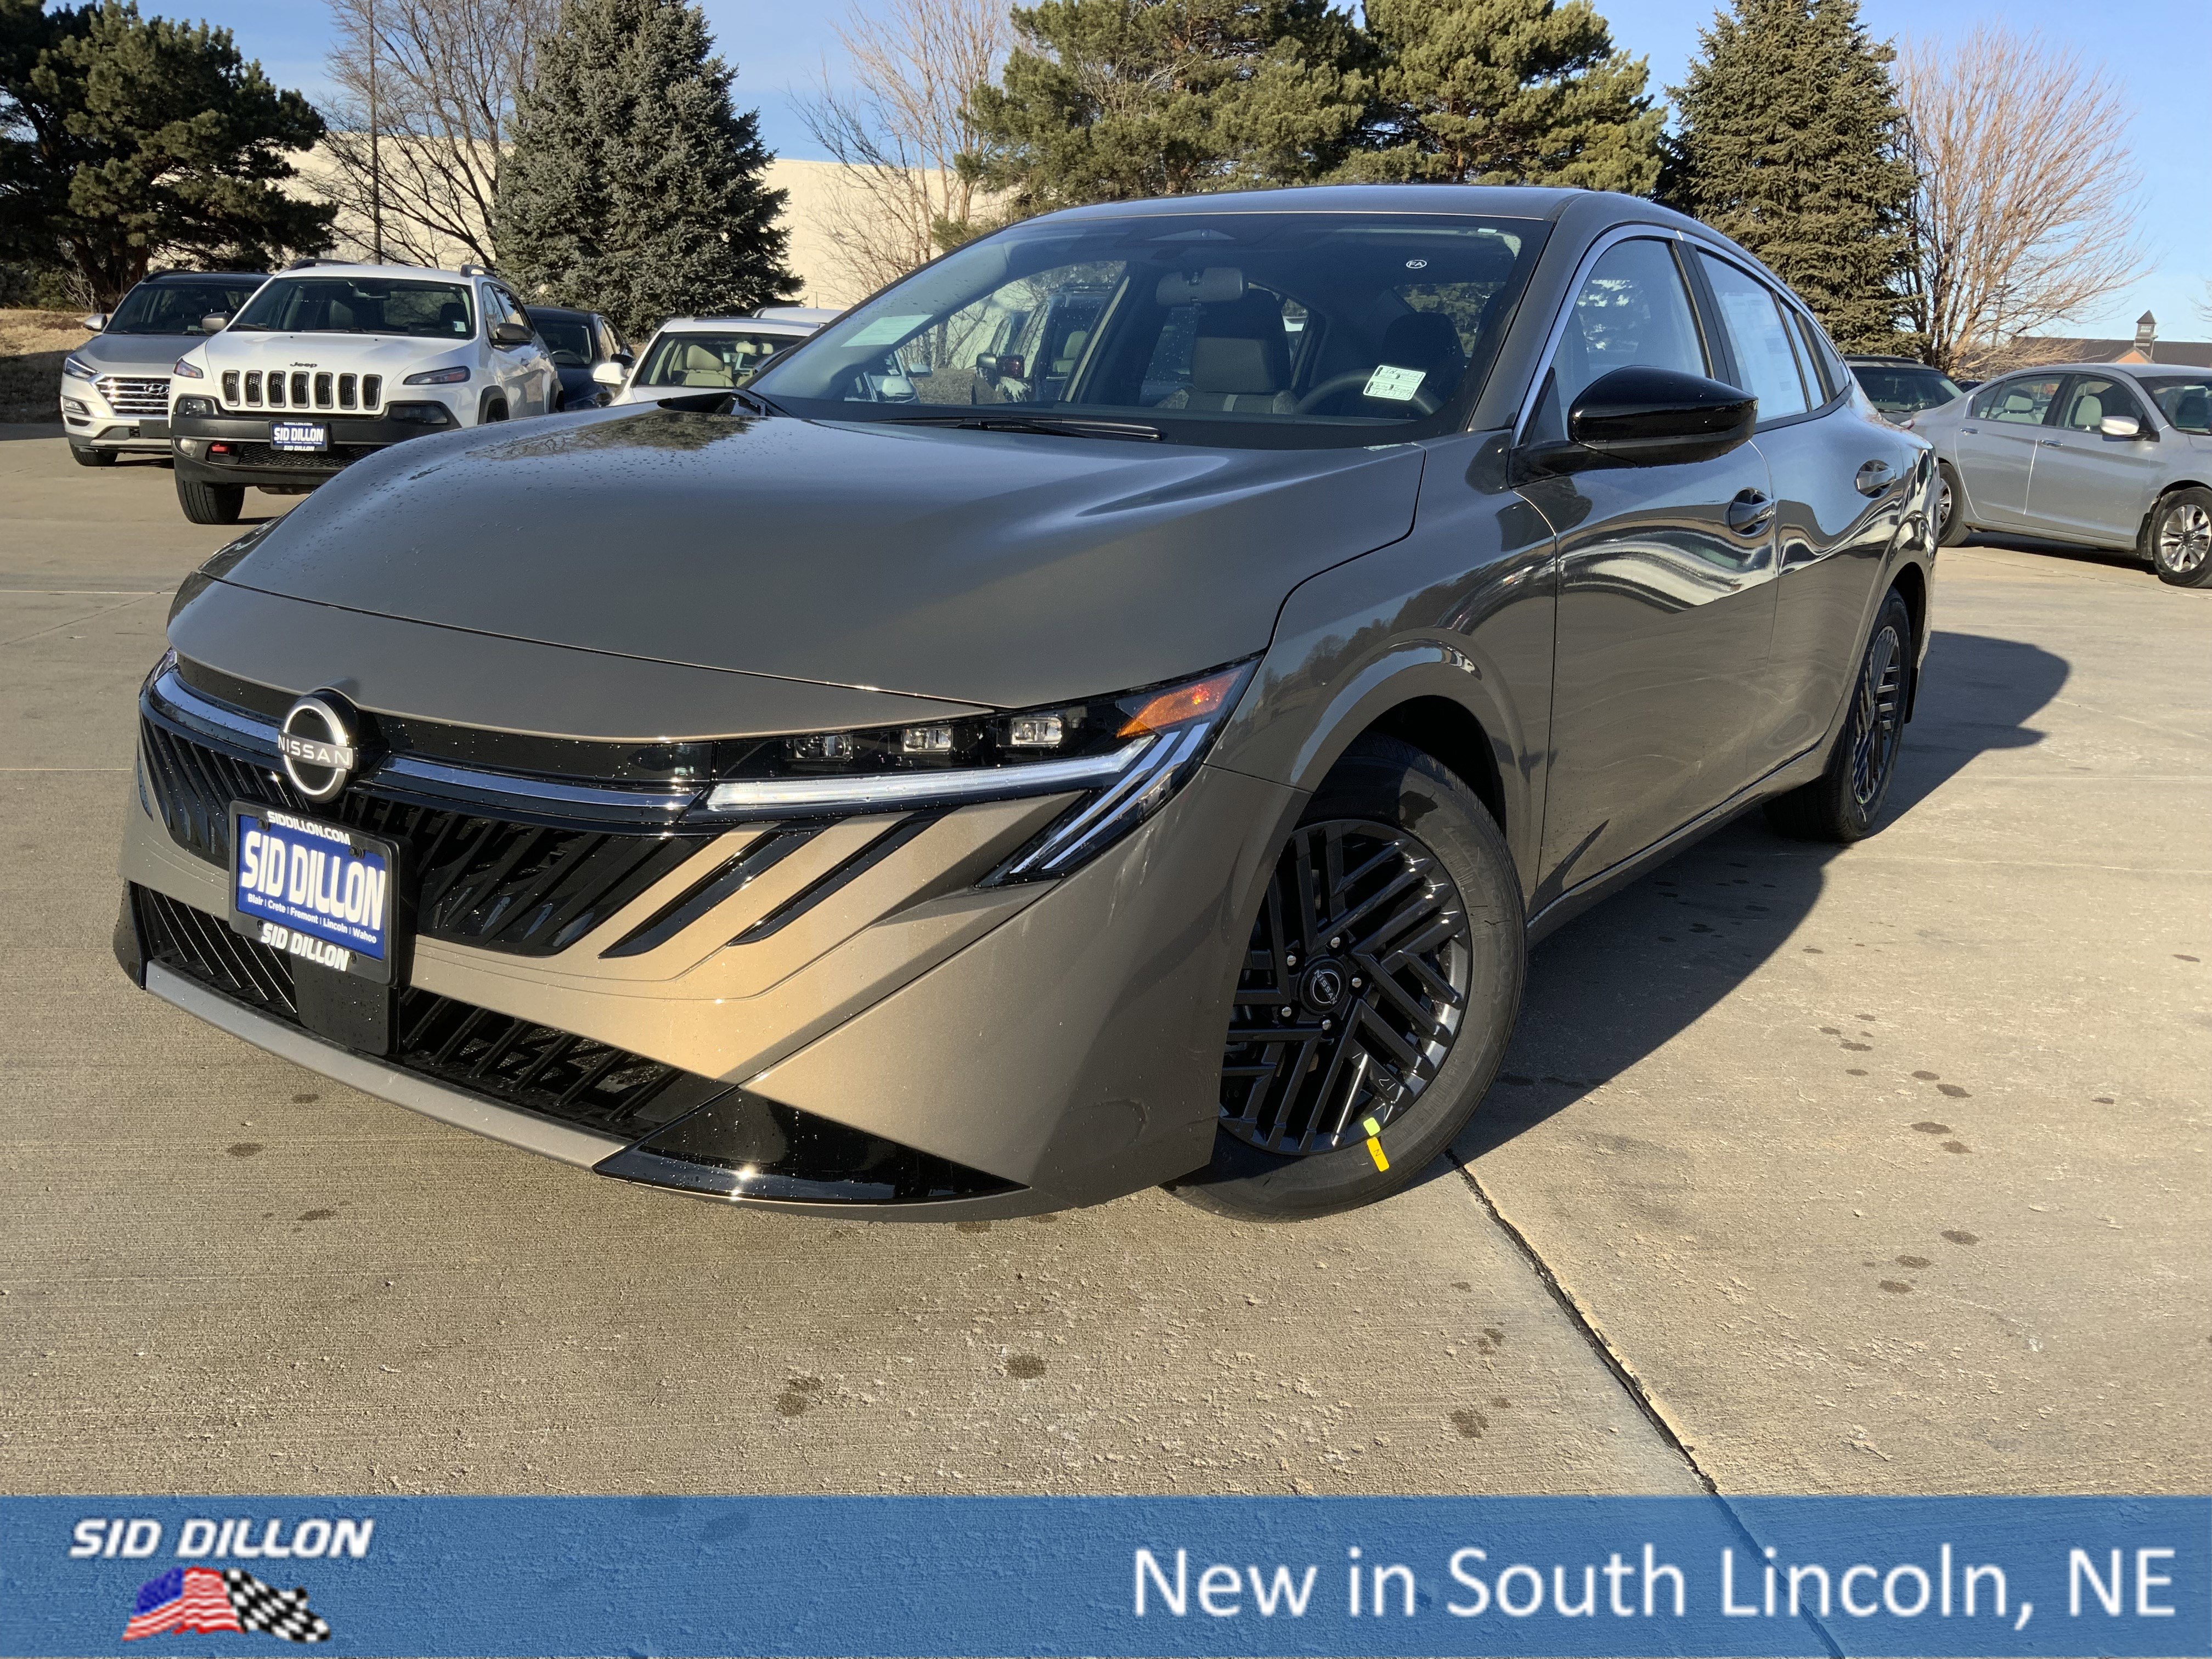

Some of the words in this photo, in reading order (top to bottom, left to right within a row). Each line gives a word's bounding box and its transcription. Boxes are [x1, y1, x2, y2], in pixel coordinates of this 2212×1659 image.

[274, 427, 290, 441] SID
[291, 428, 324, 442] DILLON
[278, 734, 349, 765] NISSAN
[267, 811, 351, 845] SIDDILLON.COM
[241, 831, 286, 898] SID
[288, 844, 386, 931] DILLON
[248, 893, 264, 906] Blair
[268, 900, 286, 913] Crete
[290, 907, 319, 925] Fremont
[323, 917, 348, 934] Lincoln
[352, 927, 377, 944] Wahoo
[261, 923, 289, 950] SID
[290, 933, 351, 972] DILLON
[1314, 970, 1337, 1005] NISSAN
